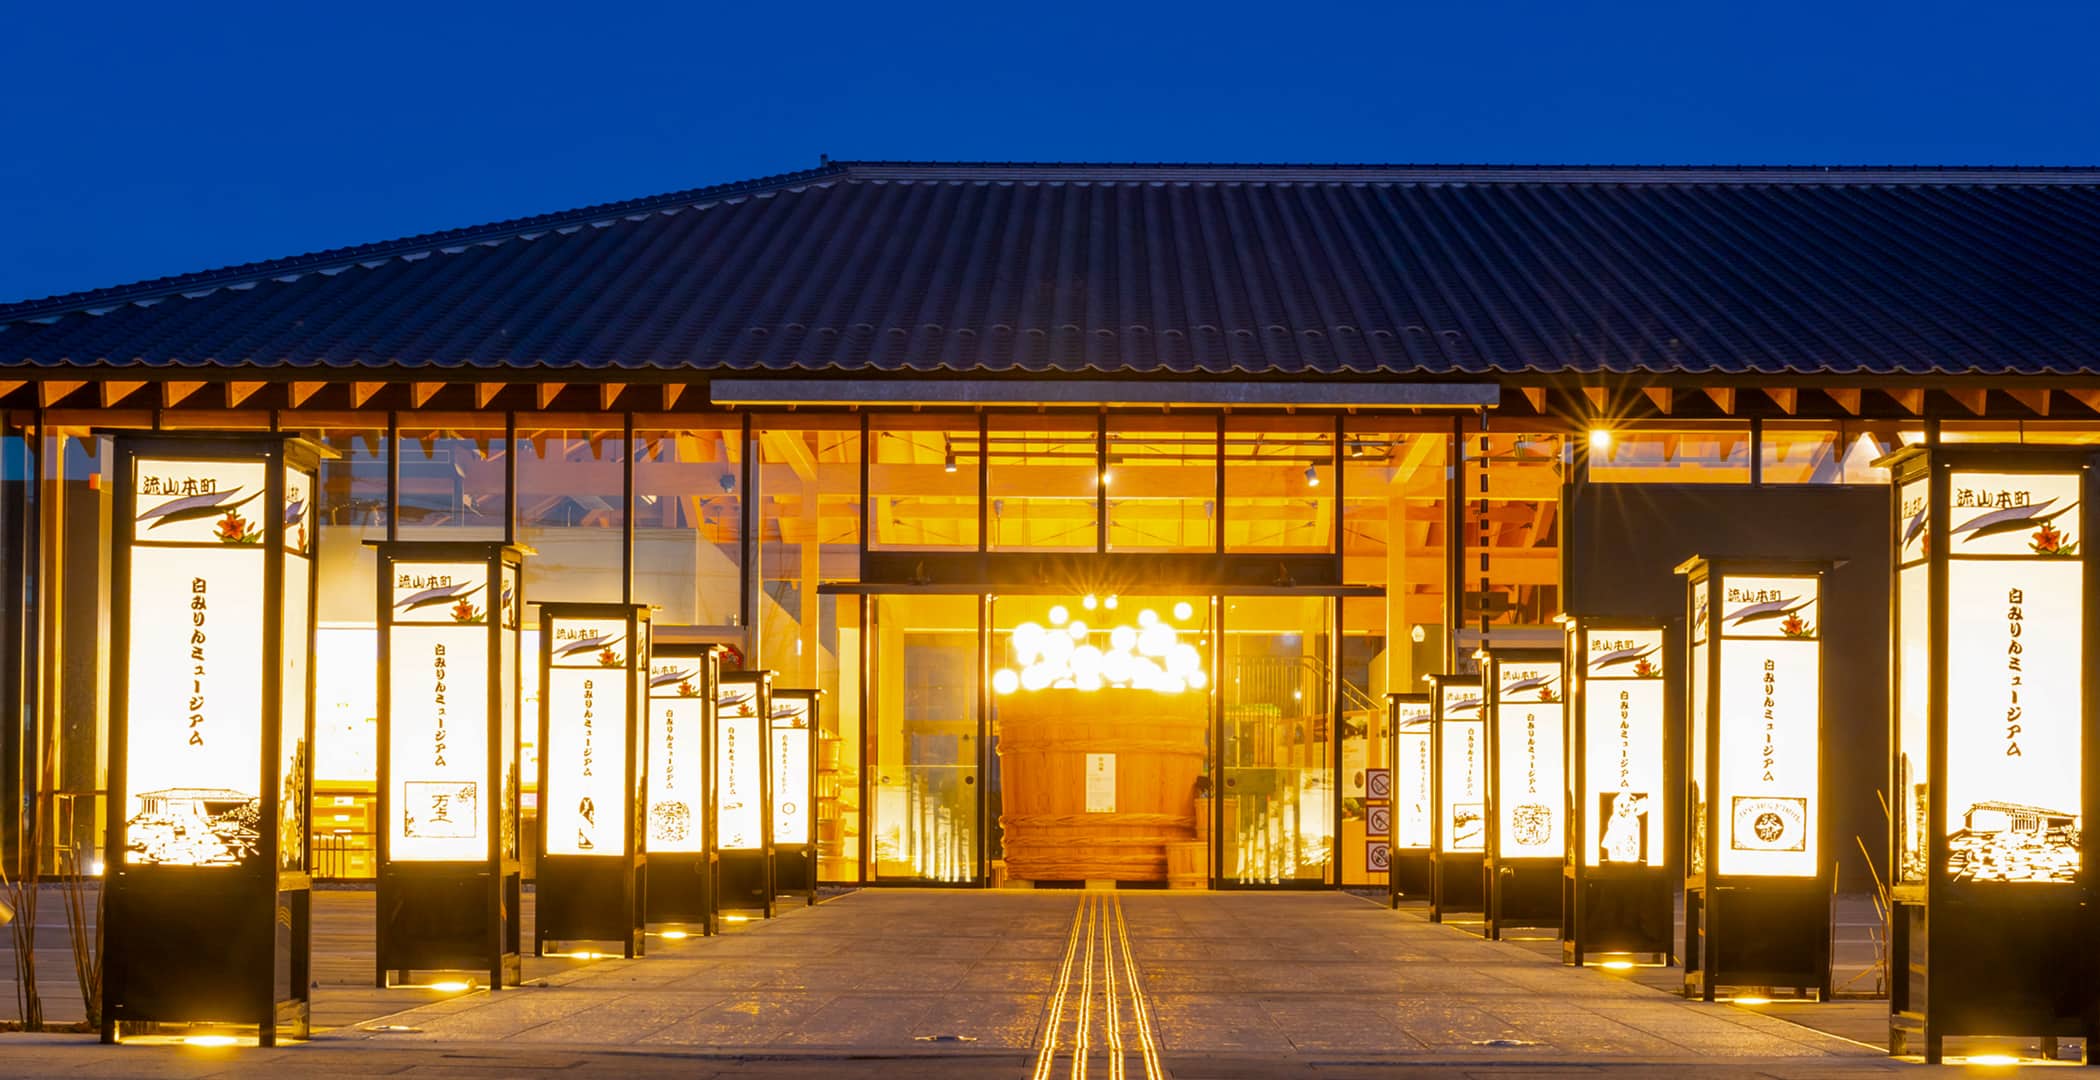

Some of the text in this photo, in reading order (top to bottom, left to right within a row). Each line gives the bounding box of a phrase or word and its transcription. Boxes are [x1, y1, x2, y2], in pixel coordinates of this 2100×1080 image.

[142, 475, 217, 497] 流山本町
[1956, 488, 2031, 508] 流山本町
[397, 574, 452, 590] 流山本町
[1727, 588, 1782, 603] 流山本町
[555, 628, 599, 641] 流山本町
[1591, 639, 1635, 651] 流山本町
[188, 577, 208, 746] 白みりんミュージアム
[651, 665, 678, 675] 山本町
[2006, 587, 2024, 757] 白みりんミュージアム
[433, 643, 447, 767] 白みりんミュージアム
[583, 679, 594, 777] 白みりんミュージアム
[1762, 659, 1776, 782] 白みりんミュージアム
[1619, 690, 1630, 788] 白みりんミュージアム
